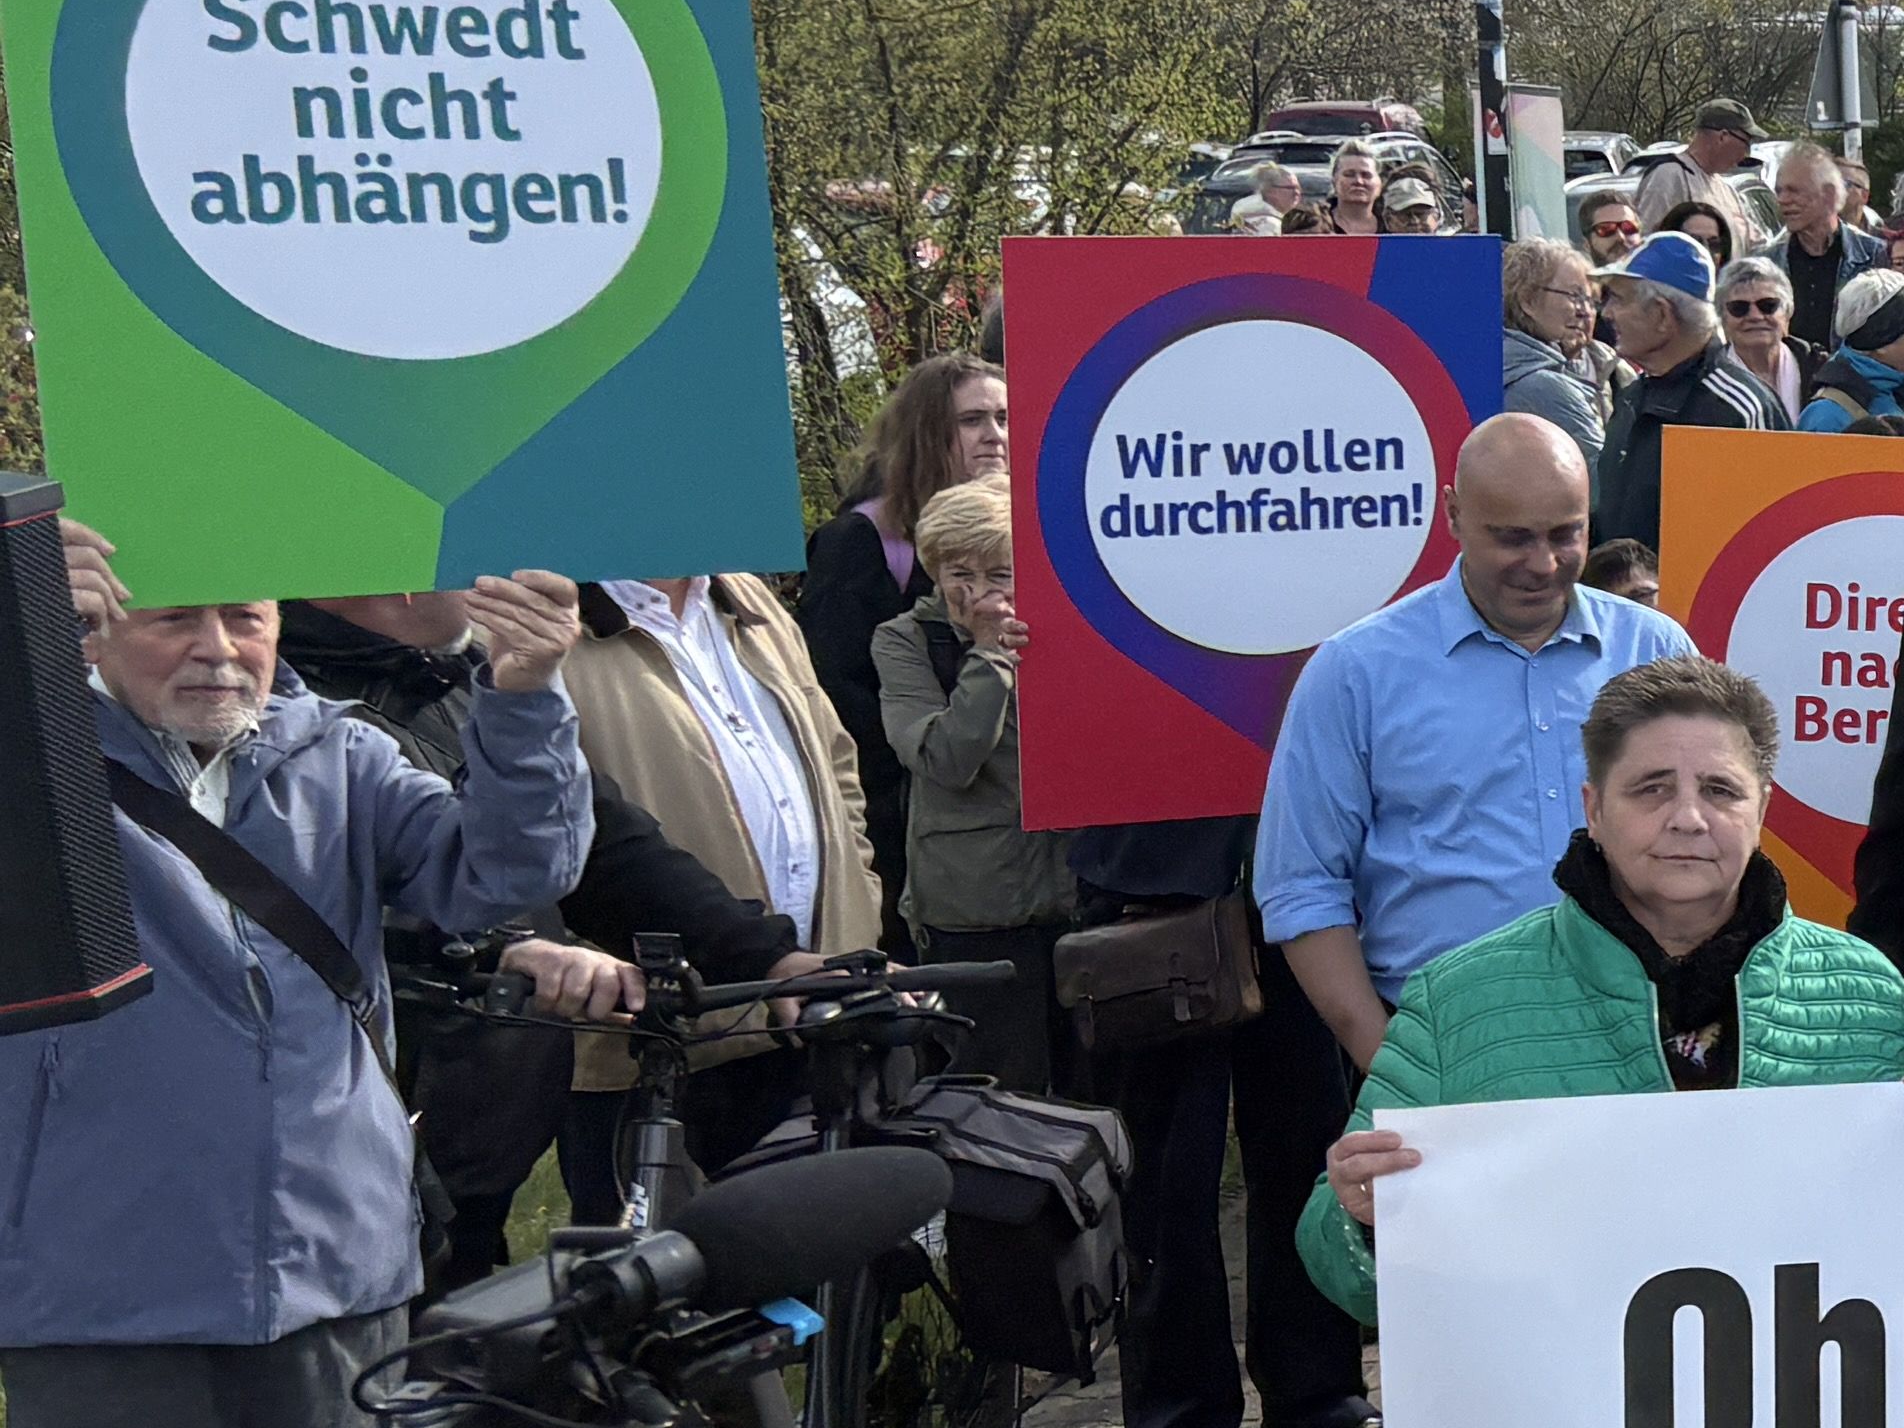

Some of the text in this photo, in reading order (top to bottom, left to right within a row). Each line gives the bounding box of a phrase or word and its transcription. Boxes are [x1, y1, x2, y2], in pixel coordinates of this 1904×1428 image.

[293, 67, 521, 142] nicht
[191, 153, 628, 244] abhängen!
[1116, 429, 1404, 479] Wir wollen
[1100, 483, 1423, 539] durchfahren!
